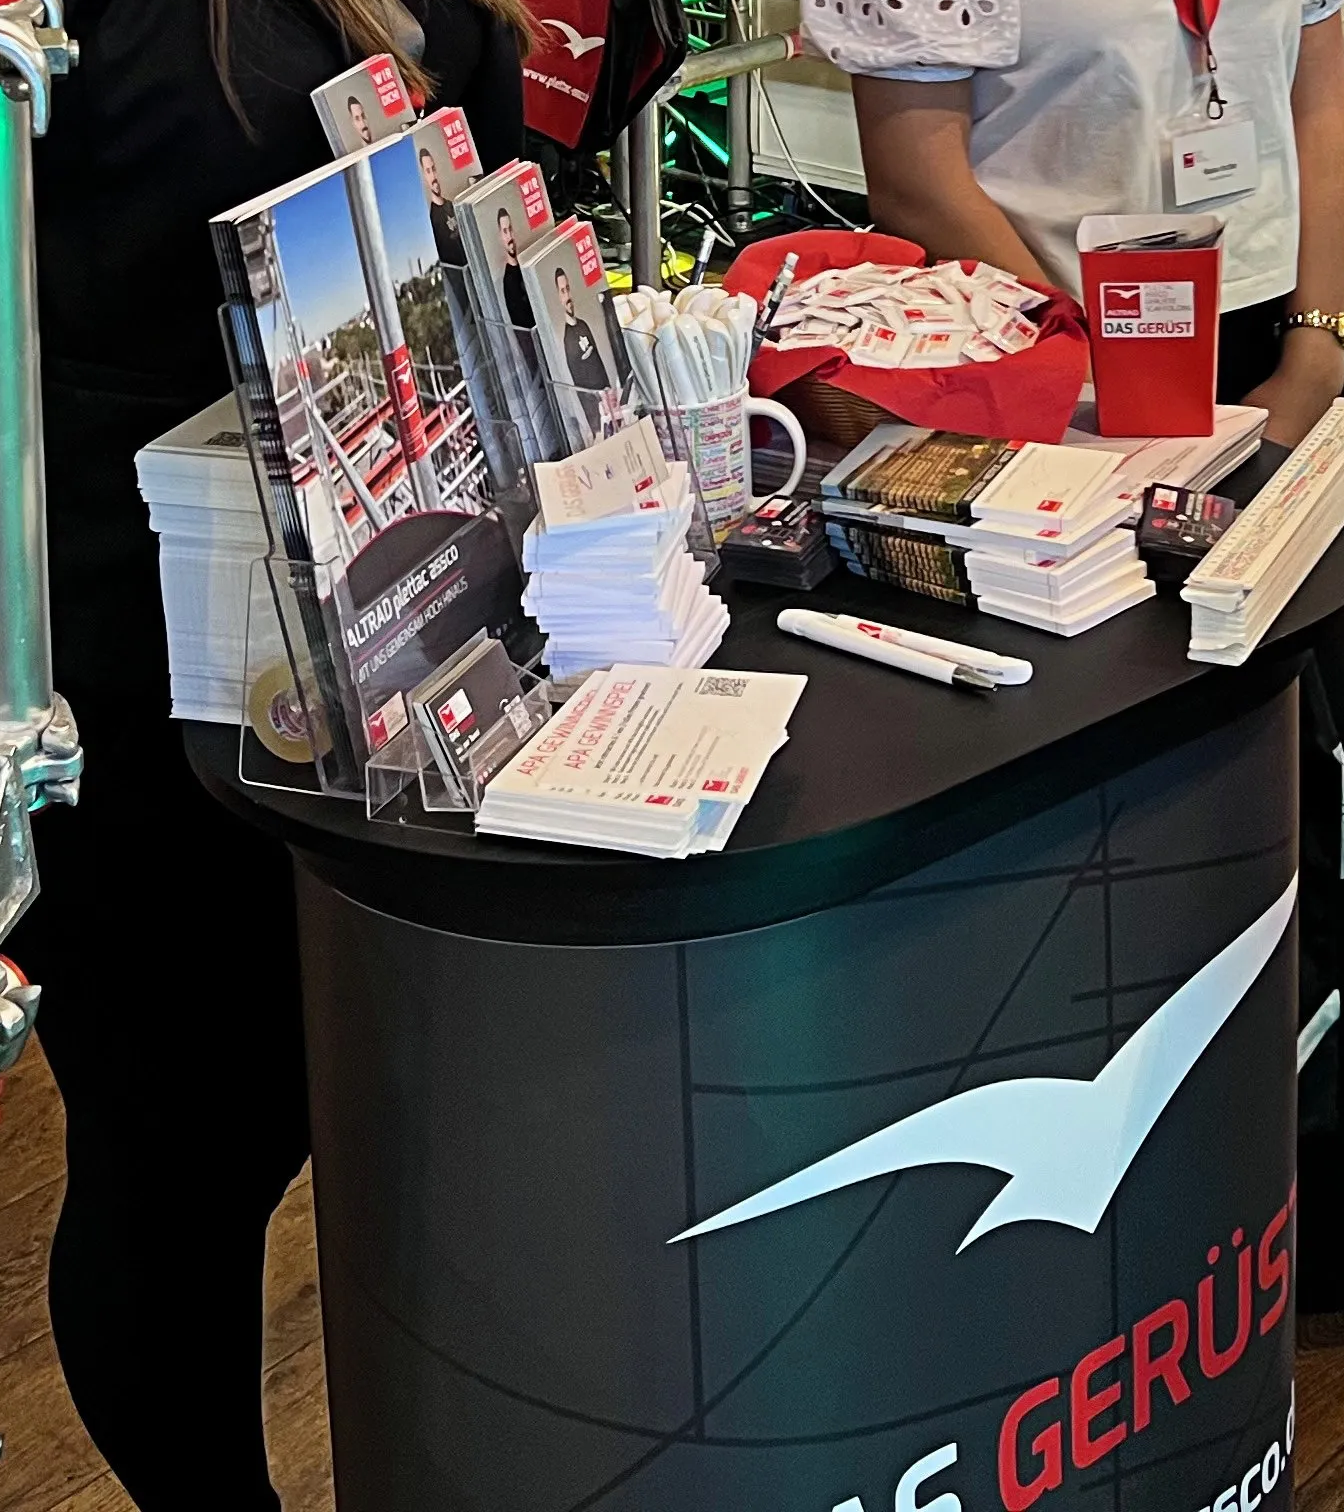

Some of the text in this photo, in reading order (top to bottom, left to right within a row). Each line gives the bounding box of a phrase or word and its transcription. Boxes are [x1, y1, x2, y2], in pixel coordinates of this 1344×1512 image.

[1104, 320, 1191, 334] DAS GERÜST
[346, 543, 459, 649] ALTRAD plettac assco
[564, 743, 592, 771] APA
[997, 1181, 1298, 1512] GERÜS
